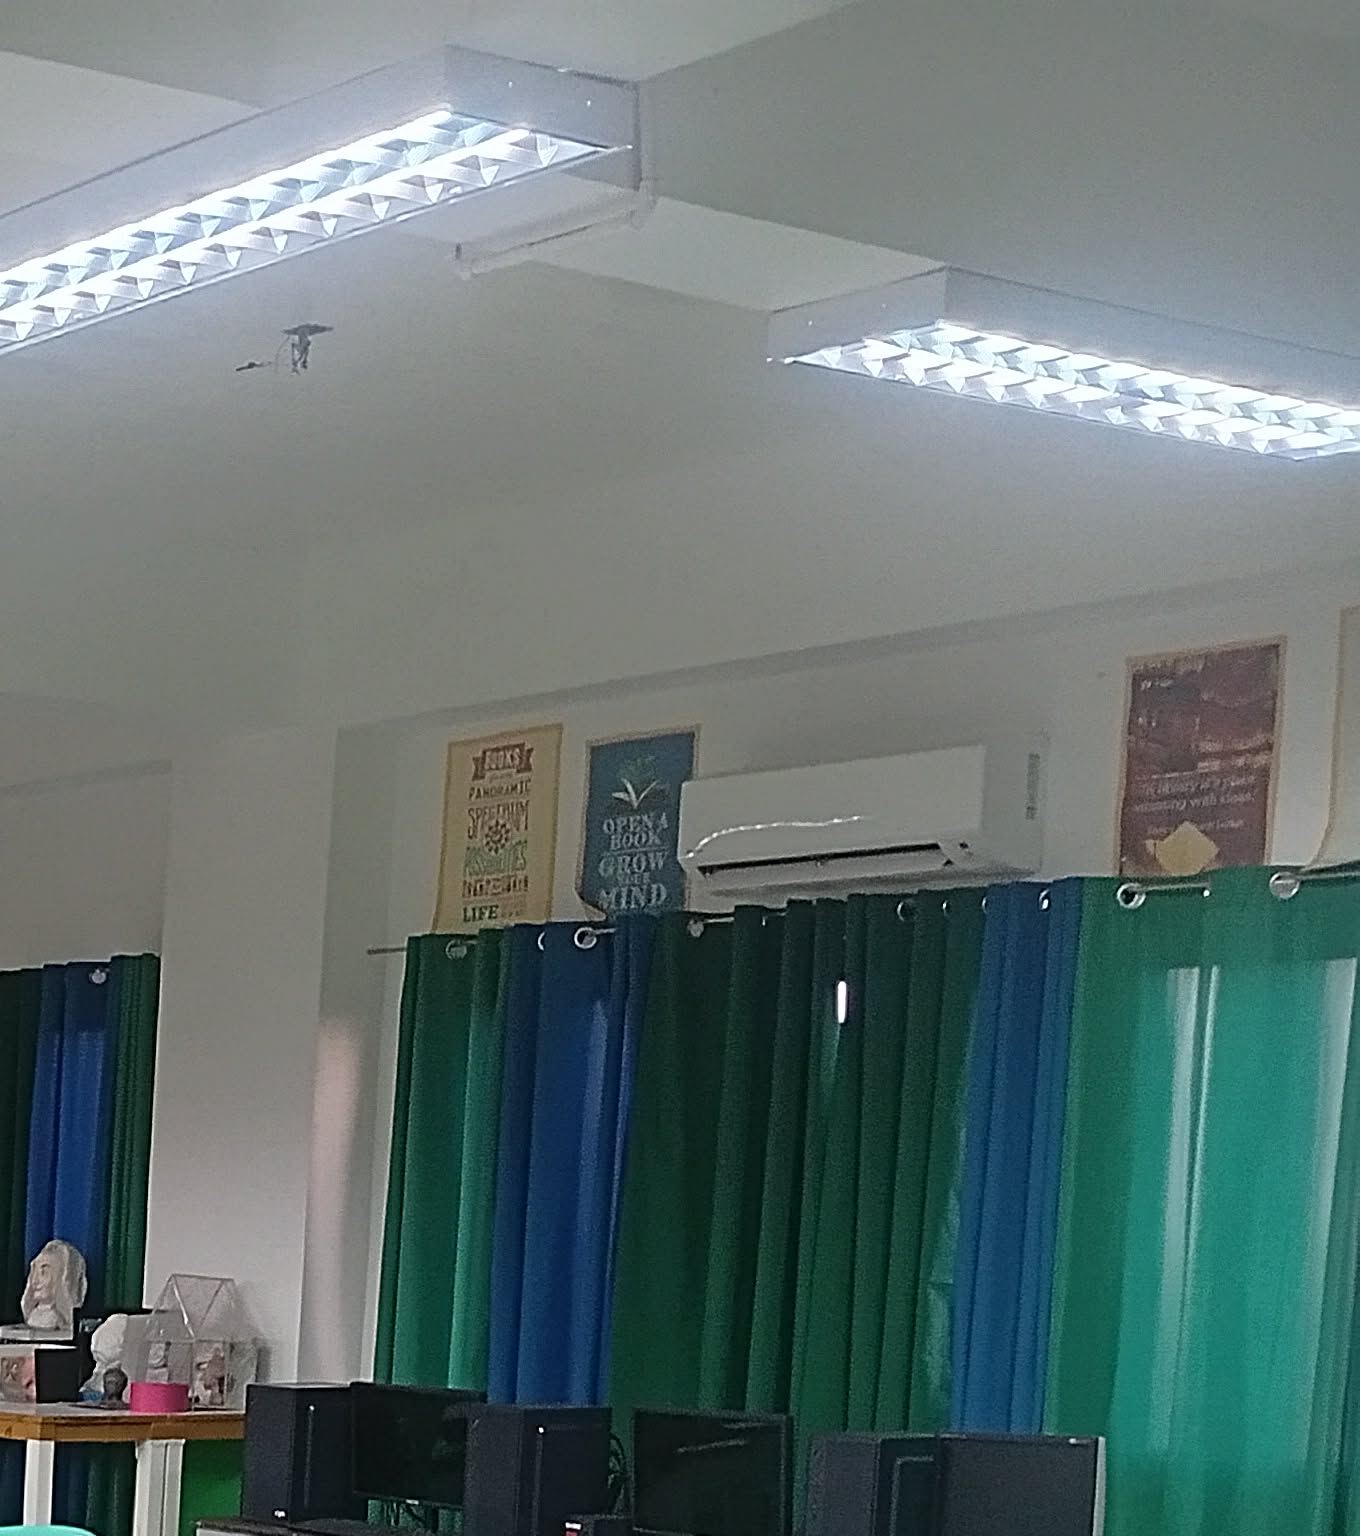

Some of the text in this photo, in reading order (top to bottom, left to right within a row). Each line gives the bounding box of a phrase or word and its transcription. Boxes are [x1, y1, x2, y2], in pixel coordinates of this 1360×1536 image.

[603, 812, 669, 834] OPEN A
[610, 832, 661, 850] BOOK
[599, 851, 669, 877] GROW
[599, 883, 667, 909] MIND
[463, 905, 499, 923] LIFE
